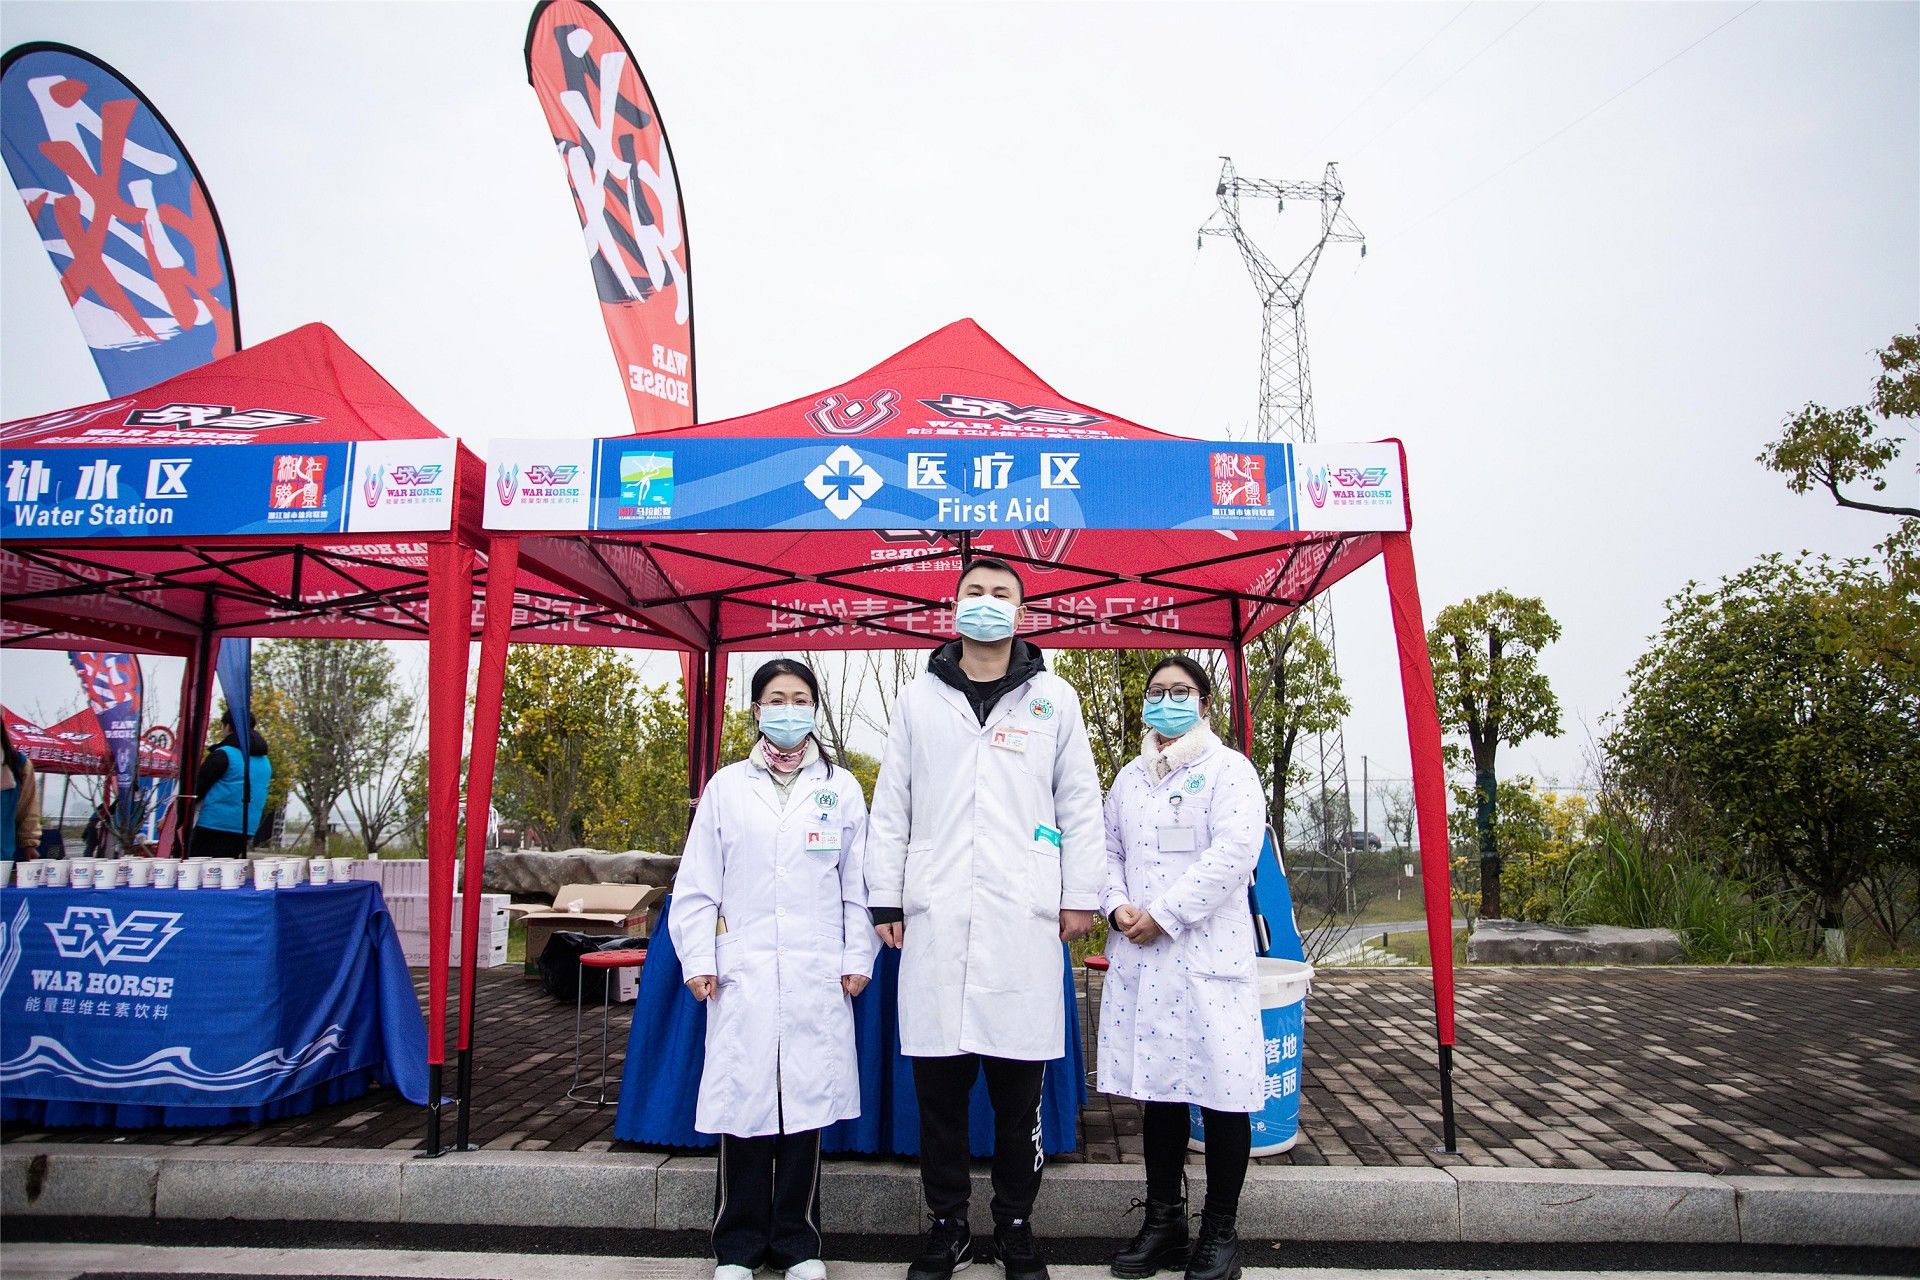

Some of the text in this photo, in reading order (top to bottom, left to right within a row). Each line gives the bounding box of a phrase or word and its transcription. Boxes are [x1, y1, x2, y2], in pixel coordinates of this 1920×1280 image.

[926, 421, 994, 430] WAR
[5, 458, 192, 502] 补水区
[907, 452, 1081, 489] 医疗区
[387, 488, 443, 497] WAR HORSE
[521, 488, 580, 497] WAR HORSE
[1332, 490, 1392, 498] WAR HORSE
[15, 502, 173, 527] Water Station
[938, 497, 1050, 523] First Aid
[31, 969, 174, 999] WAR HORSE
[24, 996, 169, 1020] 能量型维生素饮料
